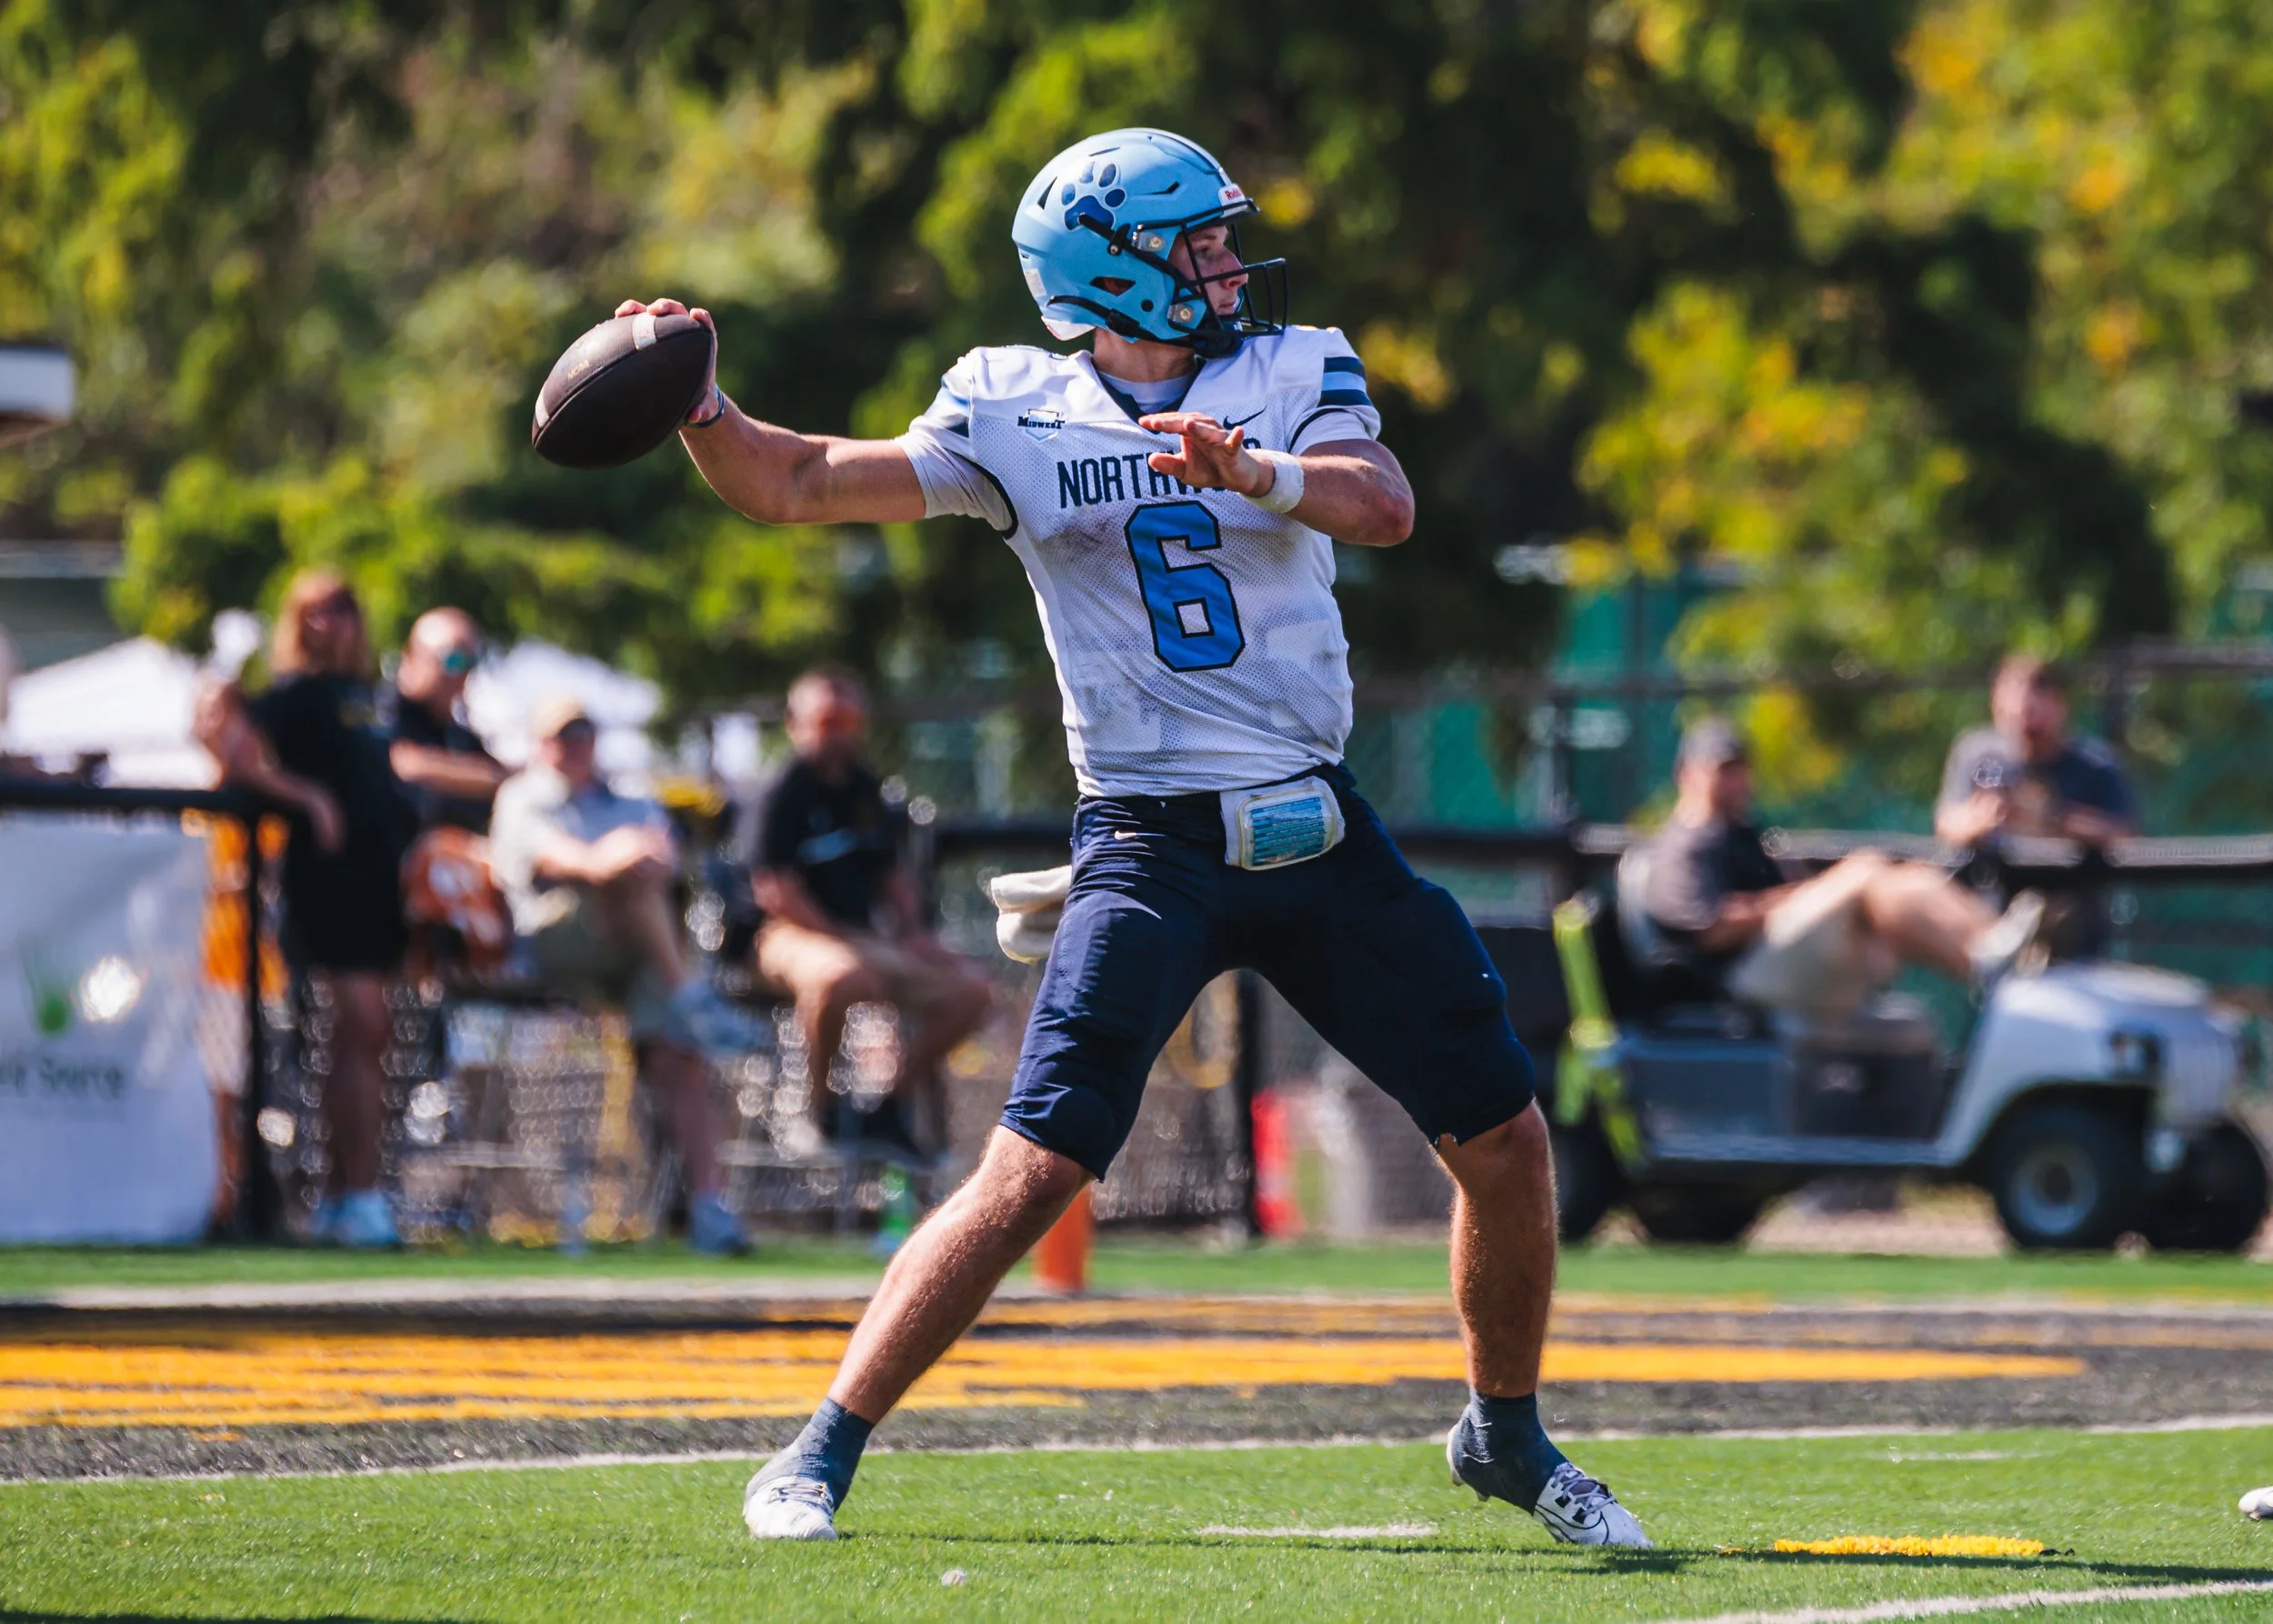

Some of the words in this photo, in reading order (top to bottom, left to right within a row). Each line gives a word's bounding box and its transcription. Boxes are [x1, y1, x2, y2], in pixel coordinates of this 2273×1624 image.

[1017, 416, 1066, 429] MIDWEST
[1056, 437, 1262, 509] NORTH
[1124, 500, 1246, 673] 6
